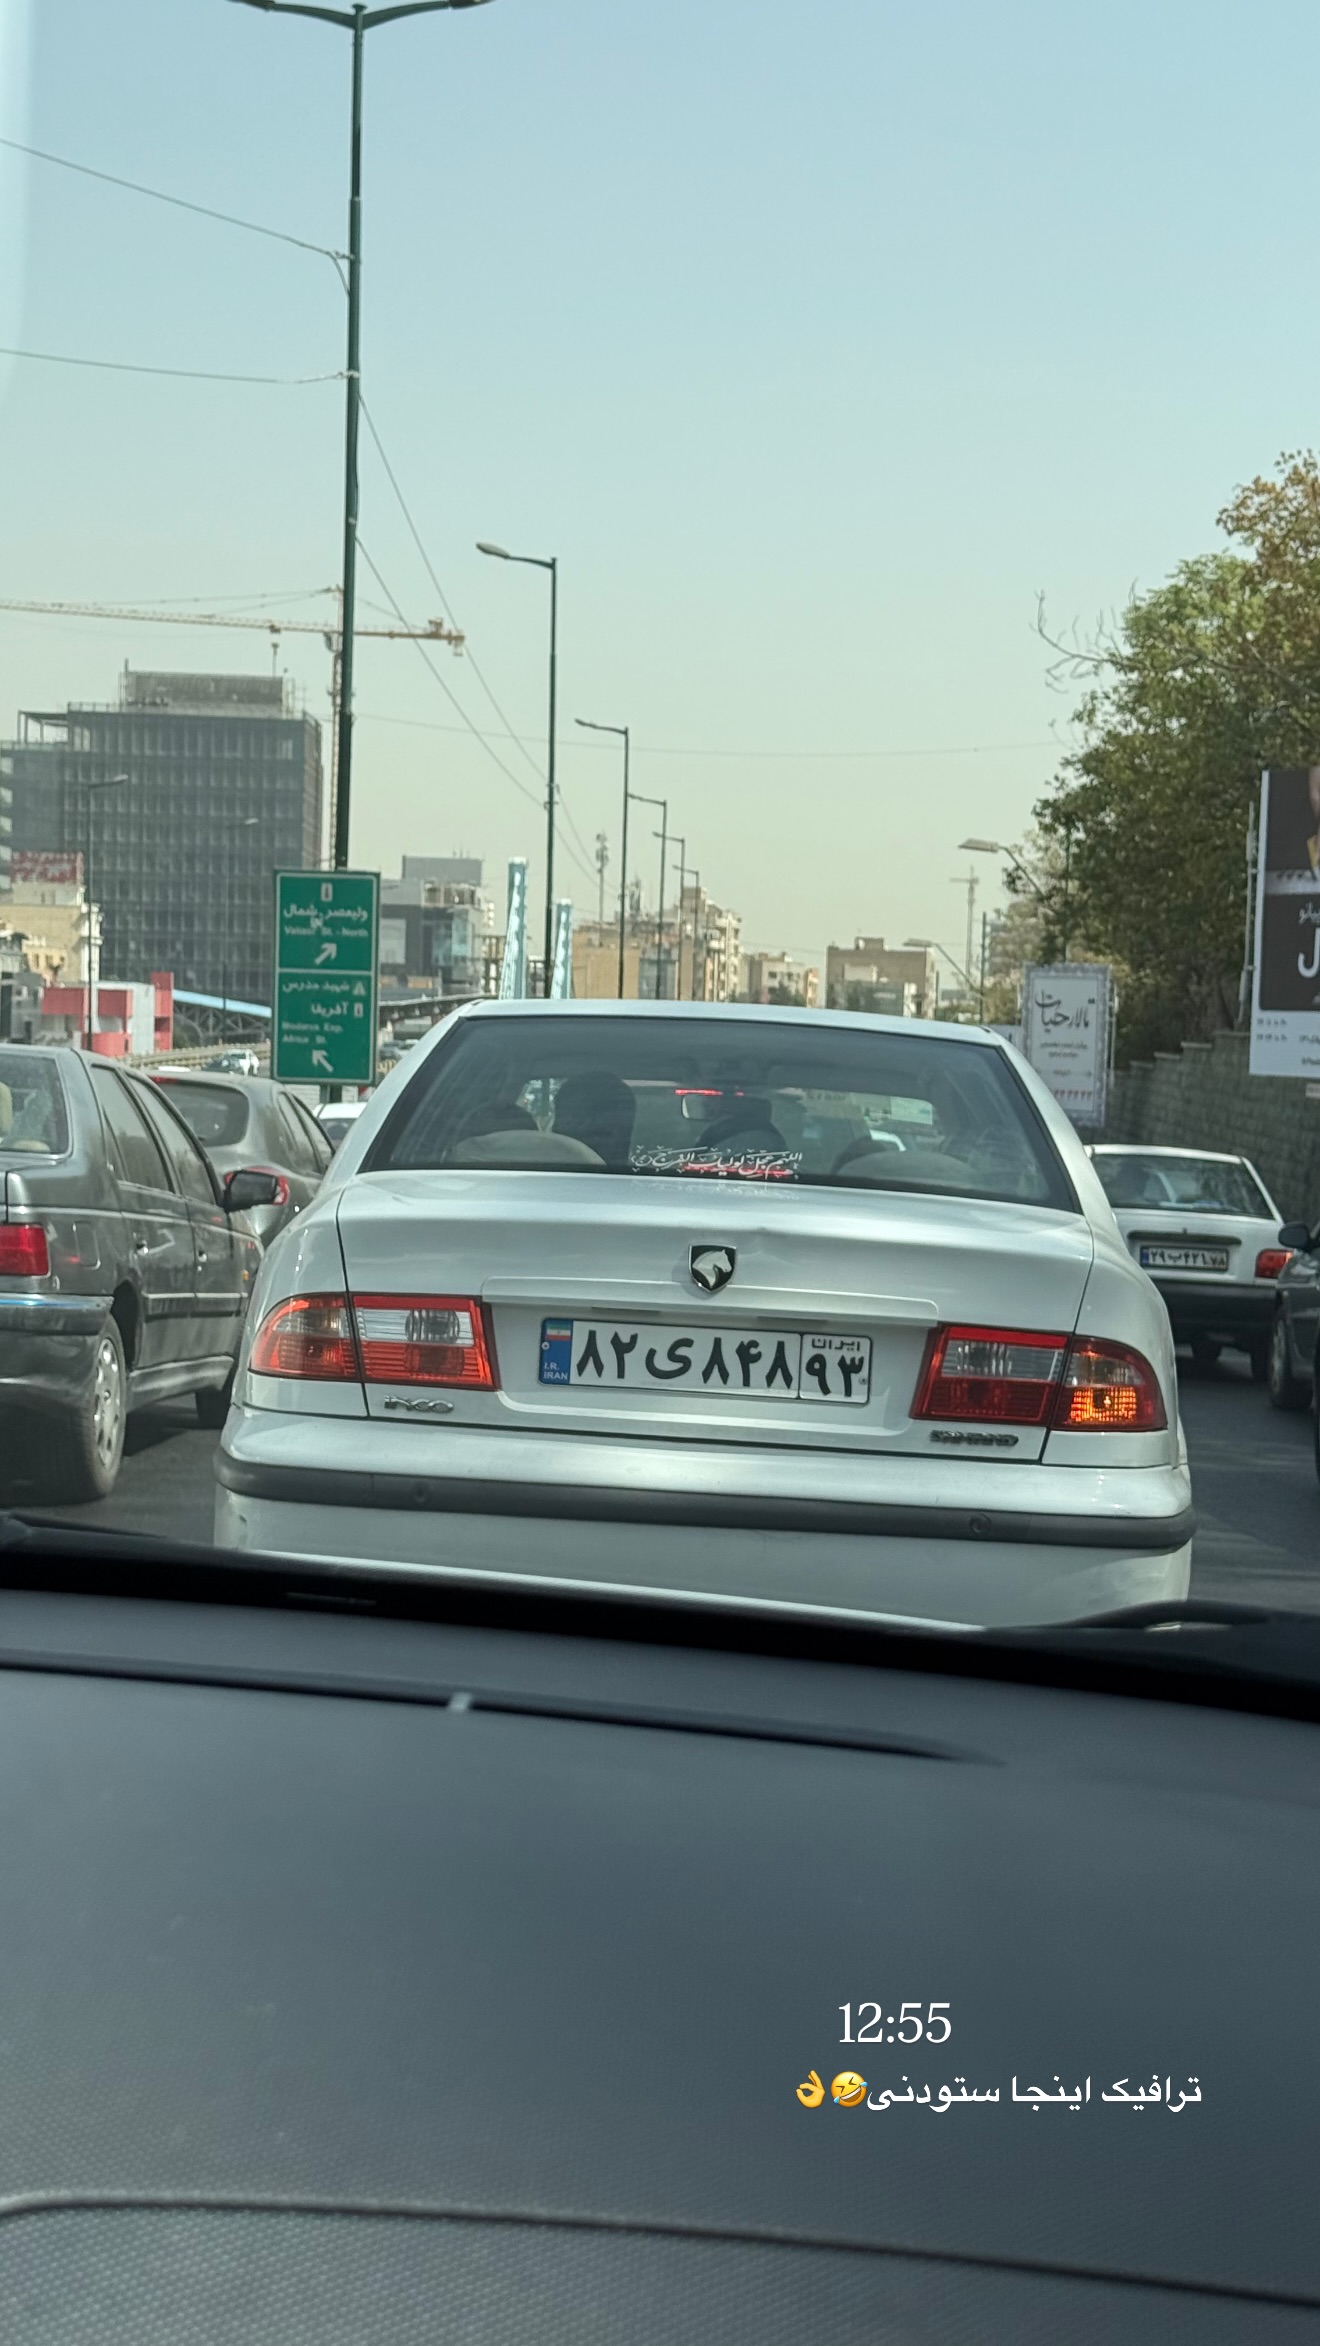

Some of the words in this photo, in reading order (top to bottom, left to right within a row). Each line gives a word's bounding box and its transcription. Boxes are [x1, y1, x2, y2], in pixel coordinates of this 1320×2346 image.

[283, 903, 318, 919] شمال
[342, 926, 369, 937] North
[282, 981, 321, 993] مدرس
[322, 981, 350, 993] شهید
[311, 1001, 349, 1018] آفریقا
[811, 1337, 861, 1352] ایران
[543, 1371, 568, 1380] IRAN
[805, 1353, 865, 1398] ۹۳
